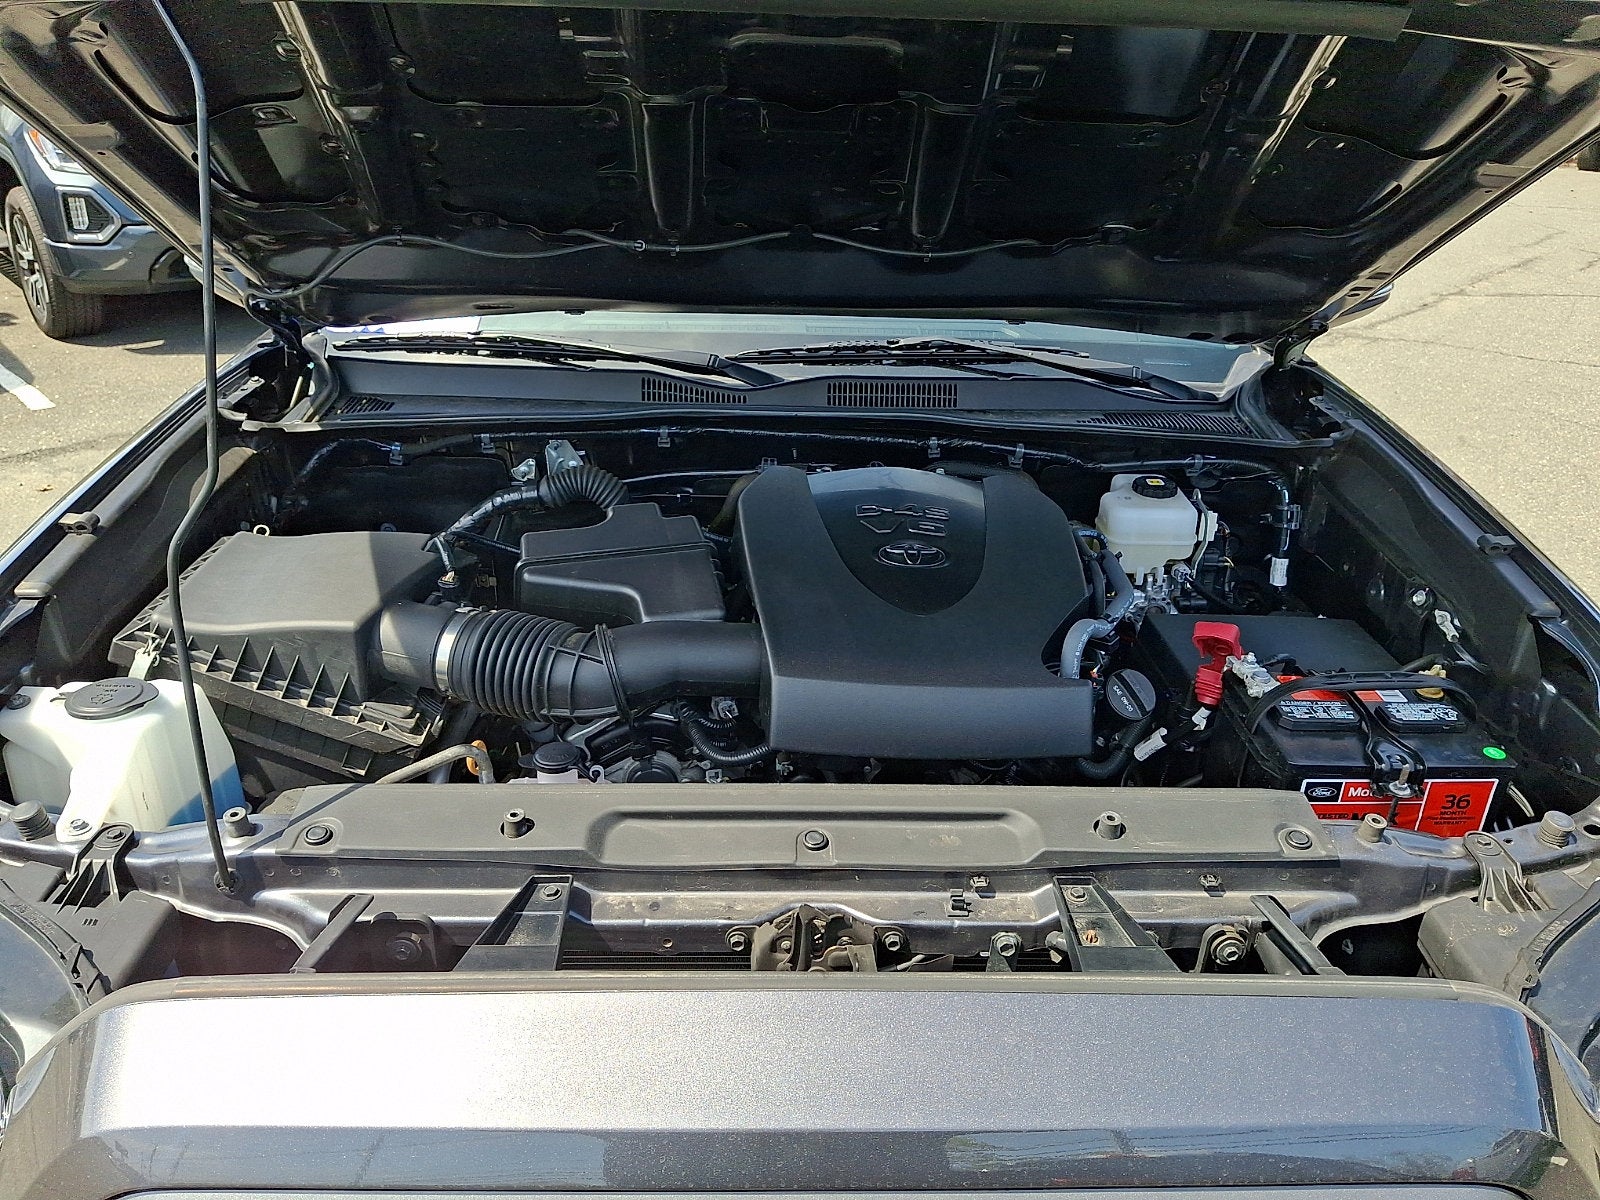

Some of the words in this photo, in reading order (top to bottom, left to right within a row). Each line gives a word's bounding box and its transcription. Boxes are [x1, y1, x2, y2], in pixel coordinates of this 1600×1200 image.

[855, 503, 950, 520] D-4S
[860, 519, 947, 537] V6
[1112, 685, 1123, 696] SAE
[1312, 788, 1332, 797] Ford
[1440, 794, 1471, 810] 36
